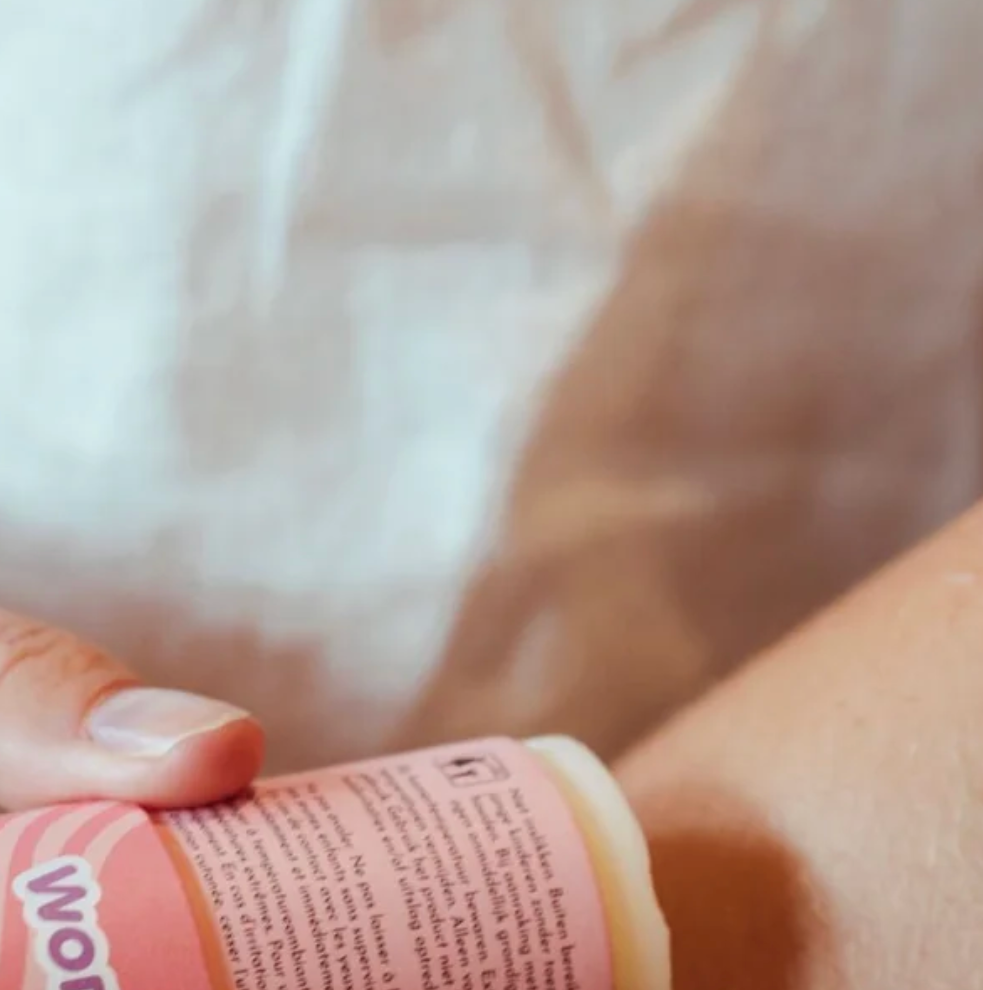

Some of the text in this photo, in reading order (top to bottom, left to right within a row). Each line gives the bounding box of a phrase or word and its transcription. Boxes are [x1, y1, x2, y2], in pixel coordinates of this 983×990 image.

[220, 860, 236, 882] En
[228, 883, 247, 909] cas
[290, 865, 306, 881] et
[296, 832, 327, 882] contact
[319, 885, 339, 921] avec
[331, 925, 346, 949] les
[317, 832, 348, 882] enfants
[339, 886, 360, 921] sans
[349, 853, 366, 878] Ne
[412, 855, 429, 880] het
[467, 830, 510, 924] onmiddellijk
[243, 865, 276, 934] extrêmes.
[267, 938, 286, 978] Pour
[355, 880, 377, 910] pas
[397, 875, 423, 932] uitslag
[417, 885, 448, 949] product
[502, 870, 532, 956] aanraking
[547, 885, 569, 940] Buiten
[218, 914, 241, 964] cesser
[368, 912, 390, 965] laisser
[450, 914, 472, 967] Alleen
[462, 889, 490, 963] bewaren.
[529, 898, 553, 955] zonder
[381, 970, 396, 983] à
[437, 954, 455, 987] niet
